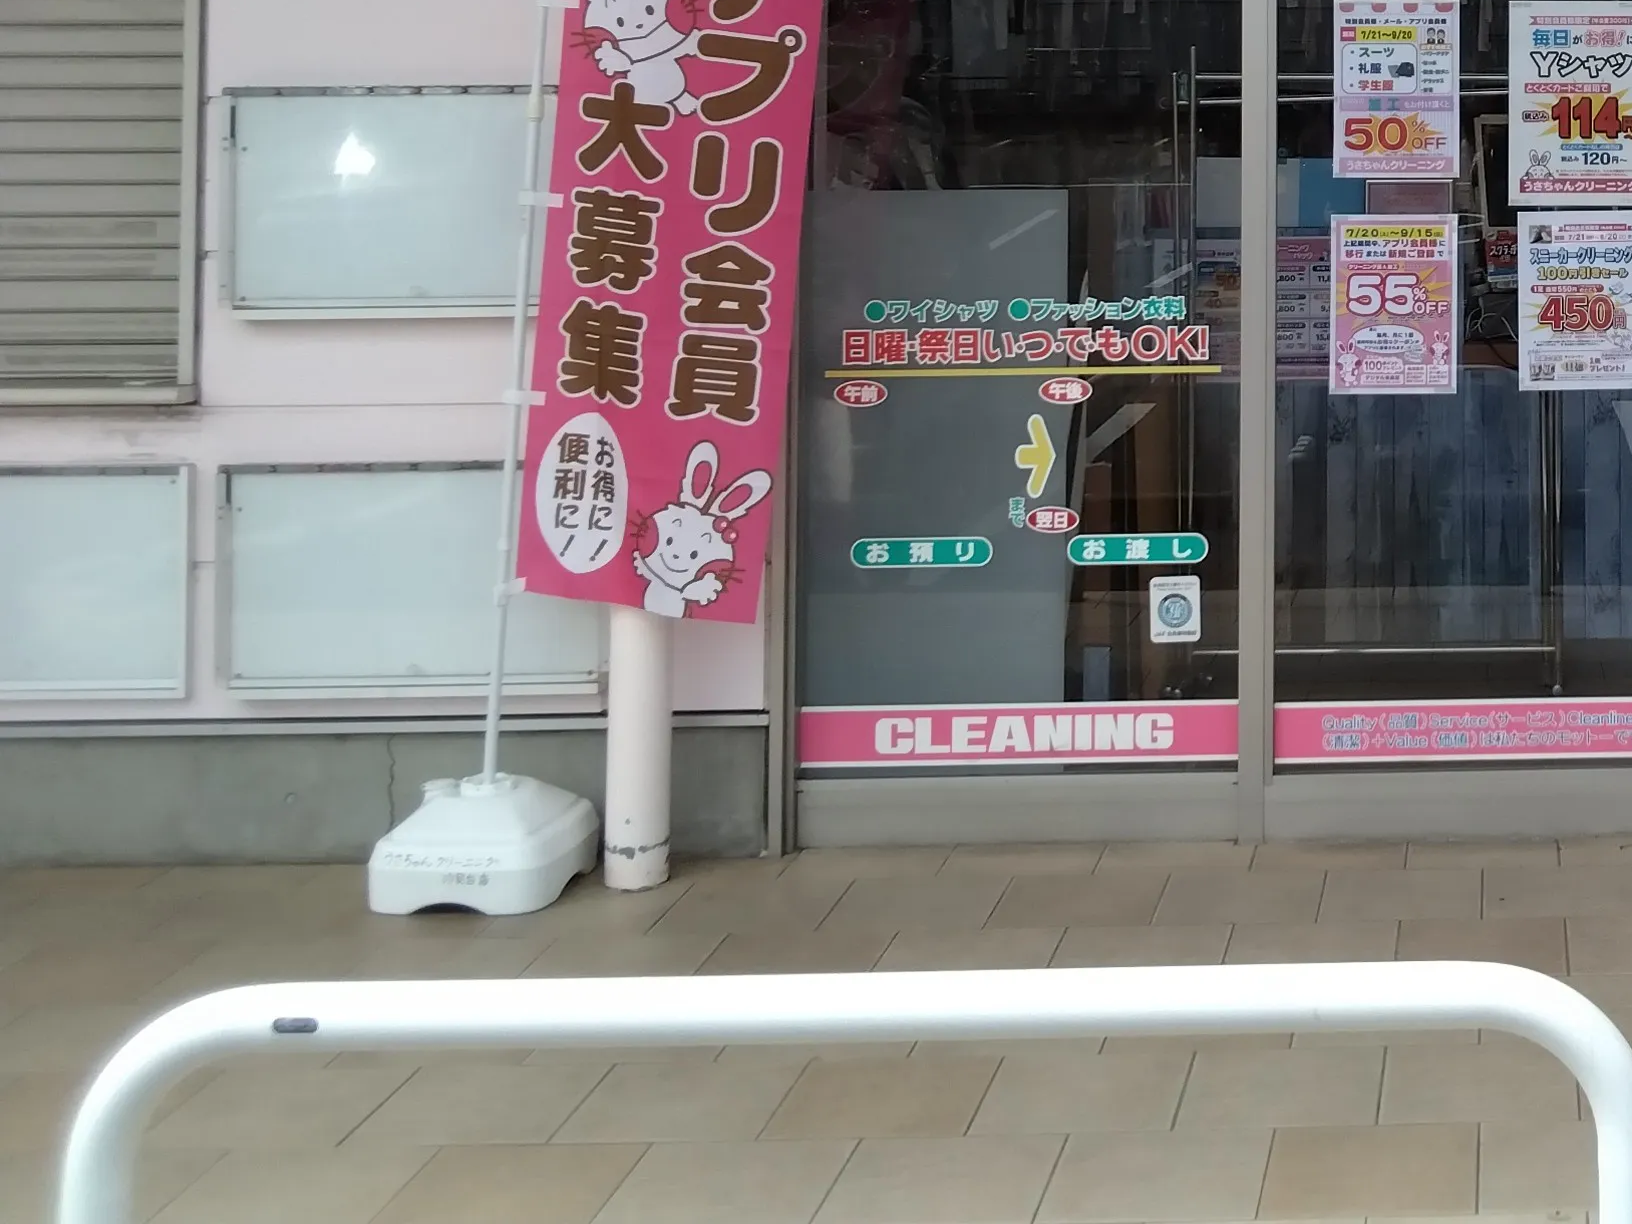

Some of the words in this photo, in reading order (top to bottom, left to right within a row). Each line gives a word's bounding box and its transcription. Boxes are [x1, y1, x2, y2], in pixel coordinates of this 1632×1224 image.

[1358, 63, 1382, 74] 礼服
[1344, 117, 1409, 151] 50
[1412, 137, 1447, 149] OFF
[1347, 160, 1445, 171] うさちゃんクリーニング
[557, 79, 674, 409] 大募集
[1346, 273, 1419, 317] 55
[1412, 301, 1449, 315] OFF
[844, 385, 879, 402] 午前
[1047, 382, 1085, 400] 午後
[1035, 511, 1069, 529] 翌日
[865, 542, 976, 564] お預り
[1082, 538, 1193, 560] お渡し
[875, 712, 1174, 754] CLEANING
